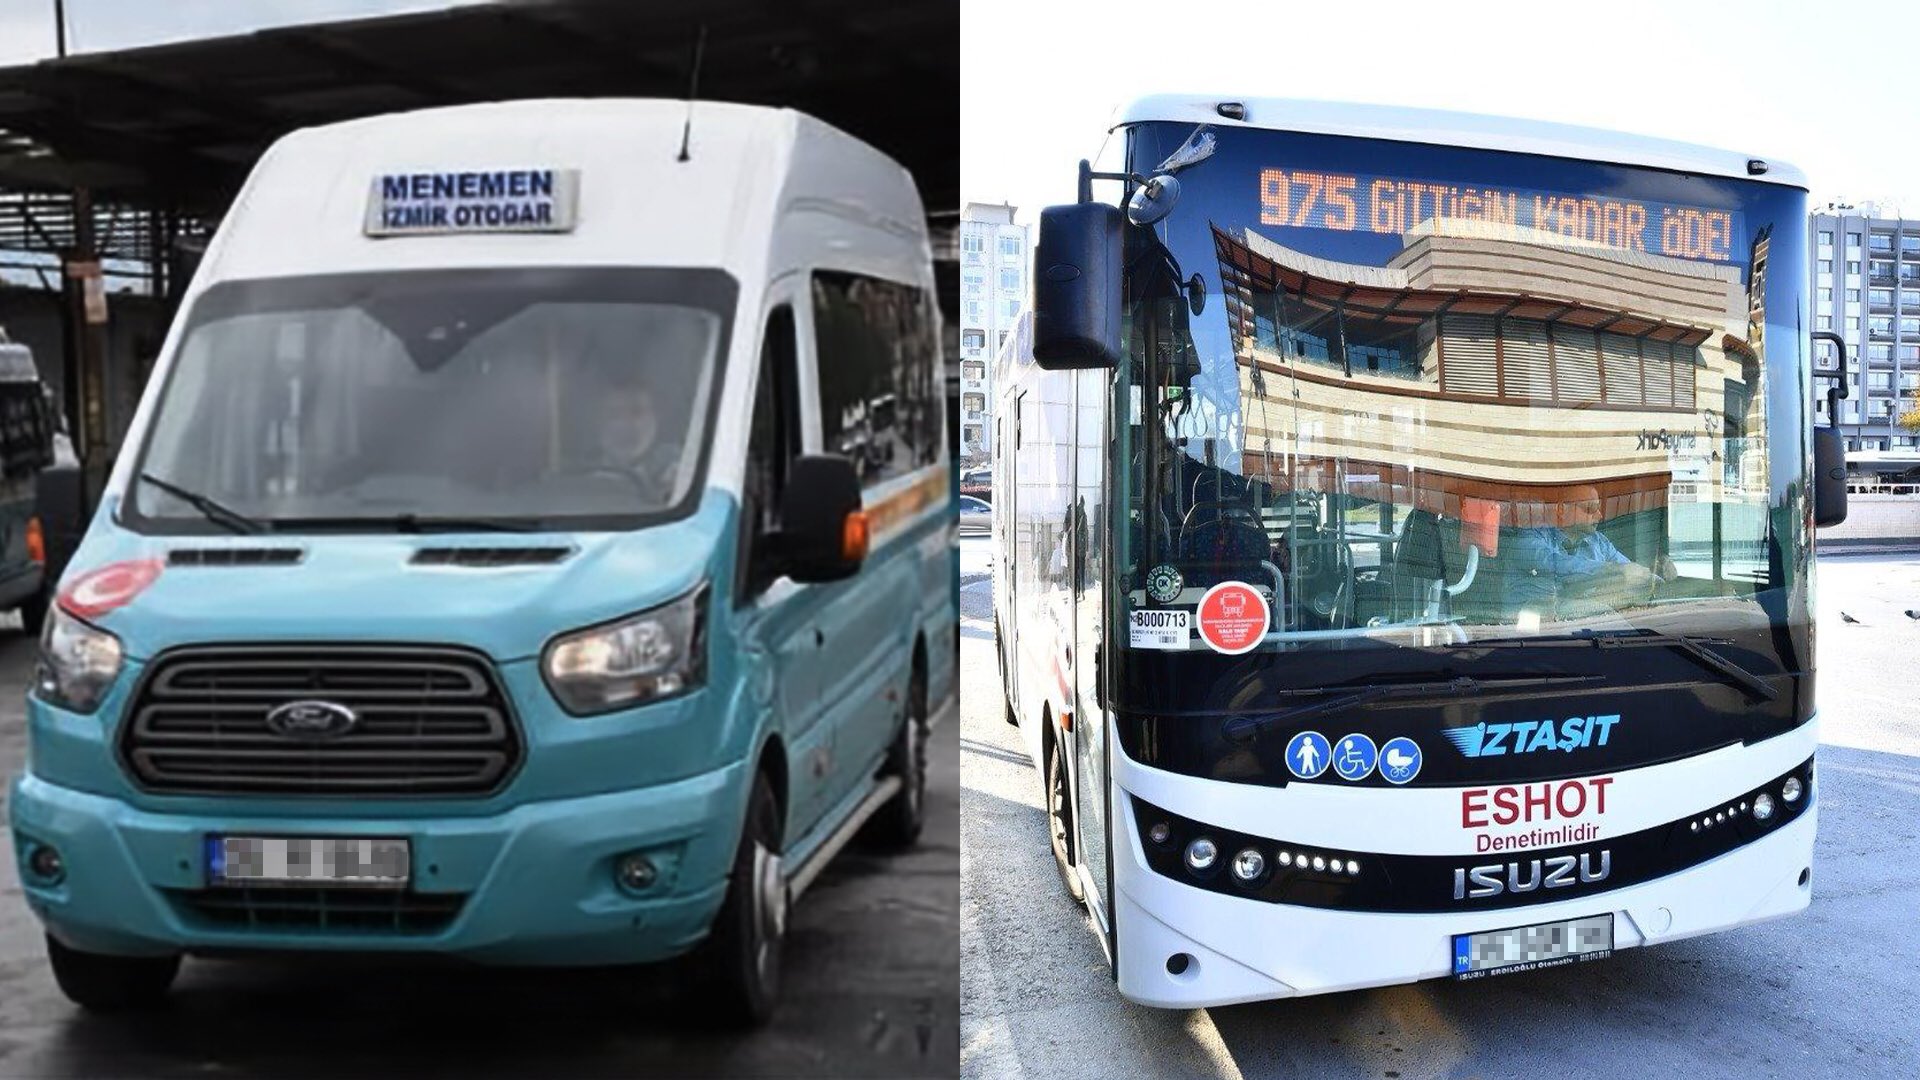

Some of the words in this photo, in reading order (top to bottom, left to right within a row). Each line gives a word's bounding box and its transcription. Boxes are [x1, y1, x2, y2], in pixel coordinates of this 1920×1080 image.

[382, 170, 552, 200] MENEMEN
[454, 203, 552, 227] OTOGAR
[1260, 168, 1356, 231] 975
[1535, 194, 1646, 251] KADAR
[1662, 206, 1732, 261] ÖDE!
[1137, 611, 1186, 628] B000713
[1462, 777, 1614, 829] ESHOT
[1476, 822, 1600, 853] Denetimlidir
[1453, 849, 1612, 900] ISUZU
[1458, 956, 1469, 966] TR
[1459, 970, 1486, 981] ISUZU
[1538, 957, 1574, 969] Otomotiv
